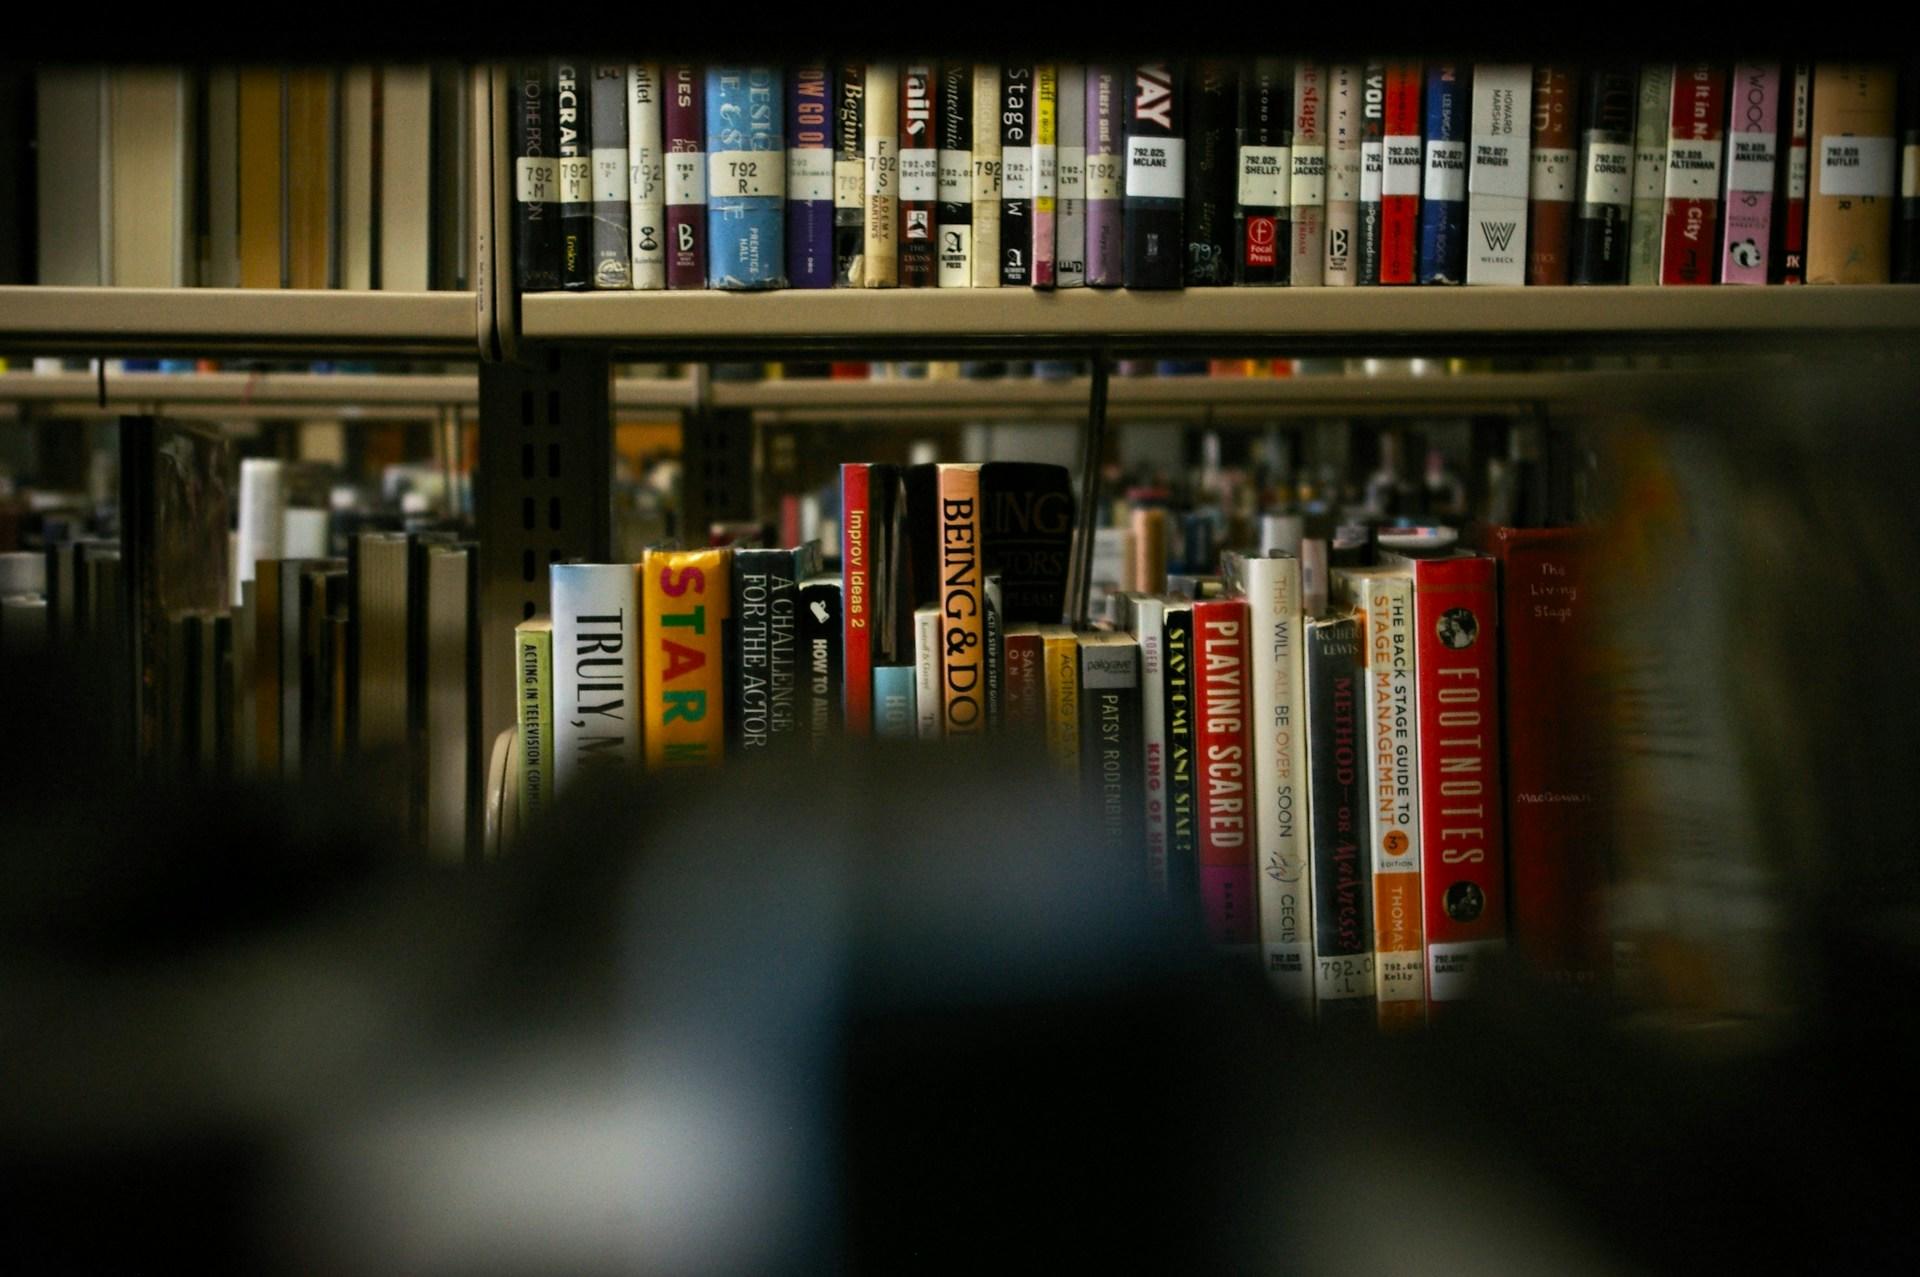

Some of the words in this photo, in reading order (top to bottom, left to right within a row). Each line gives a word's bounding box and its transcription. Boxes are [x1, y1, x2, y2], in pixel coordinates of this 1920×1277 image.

[1003, 67, 1028, 140] Stage
[1099, 74, 1112, 114] Peters
[1365, 75, 1384, 119] YOU
[1297, 85, 1319, 139] stage
[1503, 89, 1513, 134] HOWARD
[676, 163, 694, 171] 792
[869, 157, 897, 172] 792
[1132, 157, 1167, 168] MCLANE
[1133, 147, 1166, 157] 792.025
[1245, 155, 1277, 165] 792.025
[1388, 146, 1420, 157] 792.026
[1431, 149, 1463, 160] 792.027
[1476, 156, 1509, 167] BERGER
[1477, 146, 1509, 157] 792.027
[1670, 159, 1716, 171] ALTERMAN
[1826, 157, 1860, 168] BUTLER
[526, 167, 553, 183] 792
[562, 163, 589, 179] 792
[729, 162, 757, 177] 792
[975, 161, 1001, 176] 792
[1245, 165, 1281, 175] SHELLEY
[1593, 163, 1627, 174] CORSON
[1683, 206, 1704, 241] City
[740, 238, 749, 263] HALL
[749, 227, 759, 273] PRENTICE
[1249, 244, 1273, 254] Focal
[1249, 254, 1273, 264] Press
[1480, 256, 1514, 264] WELBECK
[849, 509, 865, 567] Improv
[943, 497, 977, 620] BEING
[1540, 562, 1566, 576] The
[743, 573, 766, 619] FOR
[850, 571, 865, 615] Ideas
[1272, 577, 1288, 614] THIS
[1530, 582, 1577, 601] Living
[850, 618, 865, 629] 2
[1392, 596, 1405, 627] THE
[1533, 604, 1573, 621] Stage
[660, 566, 707, 726] STAR
[743, 620, 767, 668] THE
[947, 627, 978, 656] &
[1273, 621, 1288, 662] WILL
[1373, 595, 1391, 664] STAGE
[523, 643, 538, 685] ACTING
[771, 598, 795, 733] CHALLENGE
[811, 638, 829, 674] HOW
[1322, 642, 1361, 656] LEWIS
[1393, 634, 1407, 679] BACK
[570, 606, 625, 728] TRULY,
[1203, 620, 1242, 735] PLAYING
[525, 688, 539, 701] IN
[812, 676, 829, 694] TO
[946, 664, 980, 736] DO
[1059, 652, 1076, 717] ACTING
[1274, 670, 1289, 702] ALL
[743, 673, 767, 750] ACTOR
[1100, 693, 1120, 744] PATSY
[1274, 705, 1289, 727] BE
[1394, 686, 1408, 739] STAGE
[525, 704, 541, 766] TELEVISION
[1376, 672, 1395, 826] MANAGEMENT
[1146, 743, 1161, 792] KING
[1275, 732, 1291, 780] OVER
[1396, 744, 1409, 796] GUIDE
[1437, 666, 1486, 866] FOOTNOTES
[1149, 799, 1162, 823] OF
[1207, 745, 1245, 850] SCARED
[1276, 785, 1293, 838] SOON
[1397, 803, 1410, 825] TO
[1384, 972, 1413, 982] Kelly
